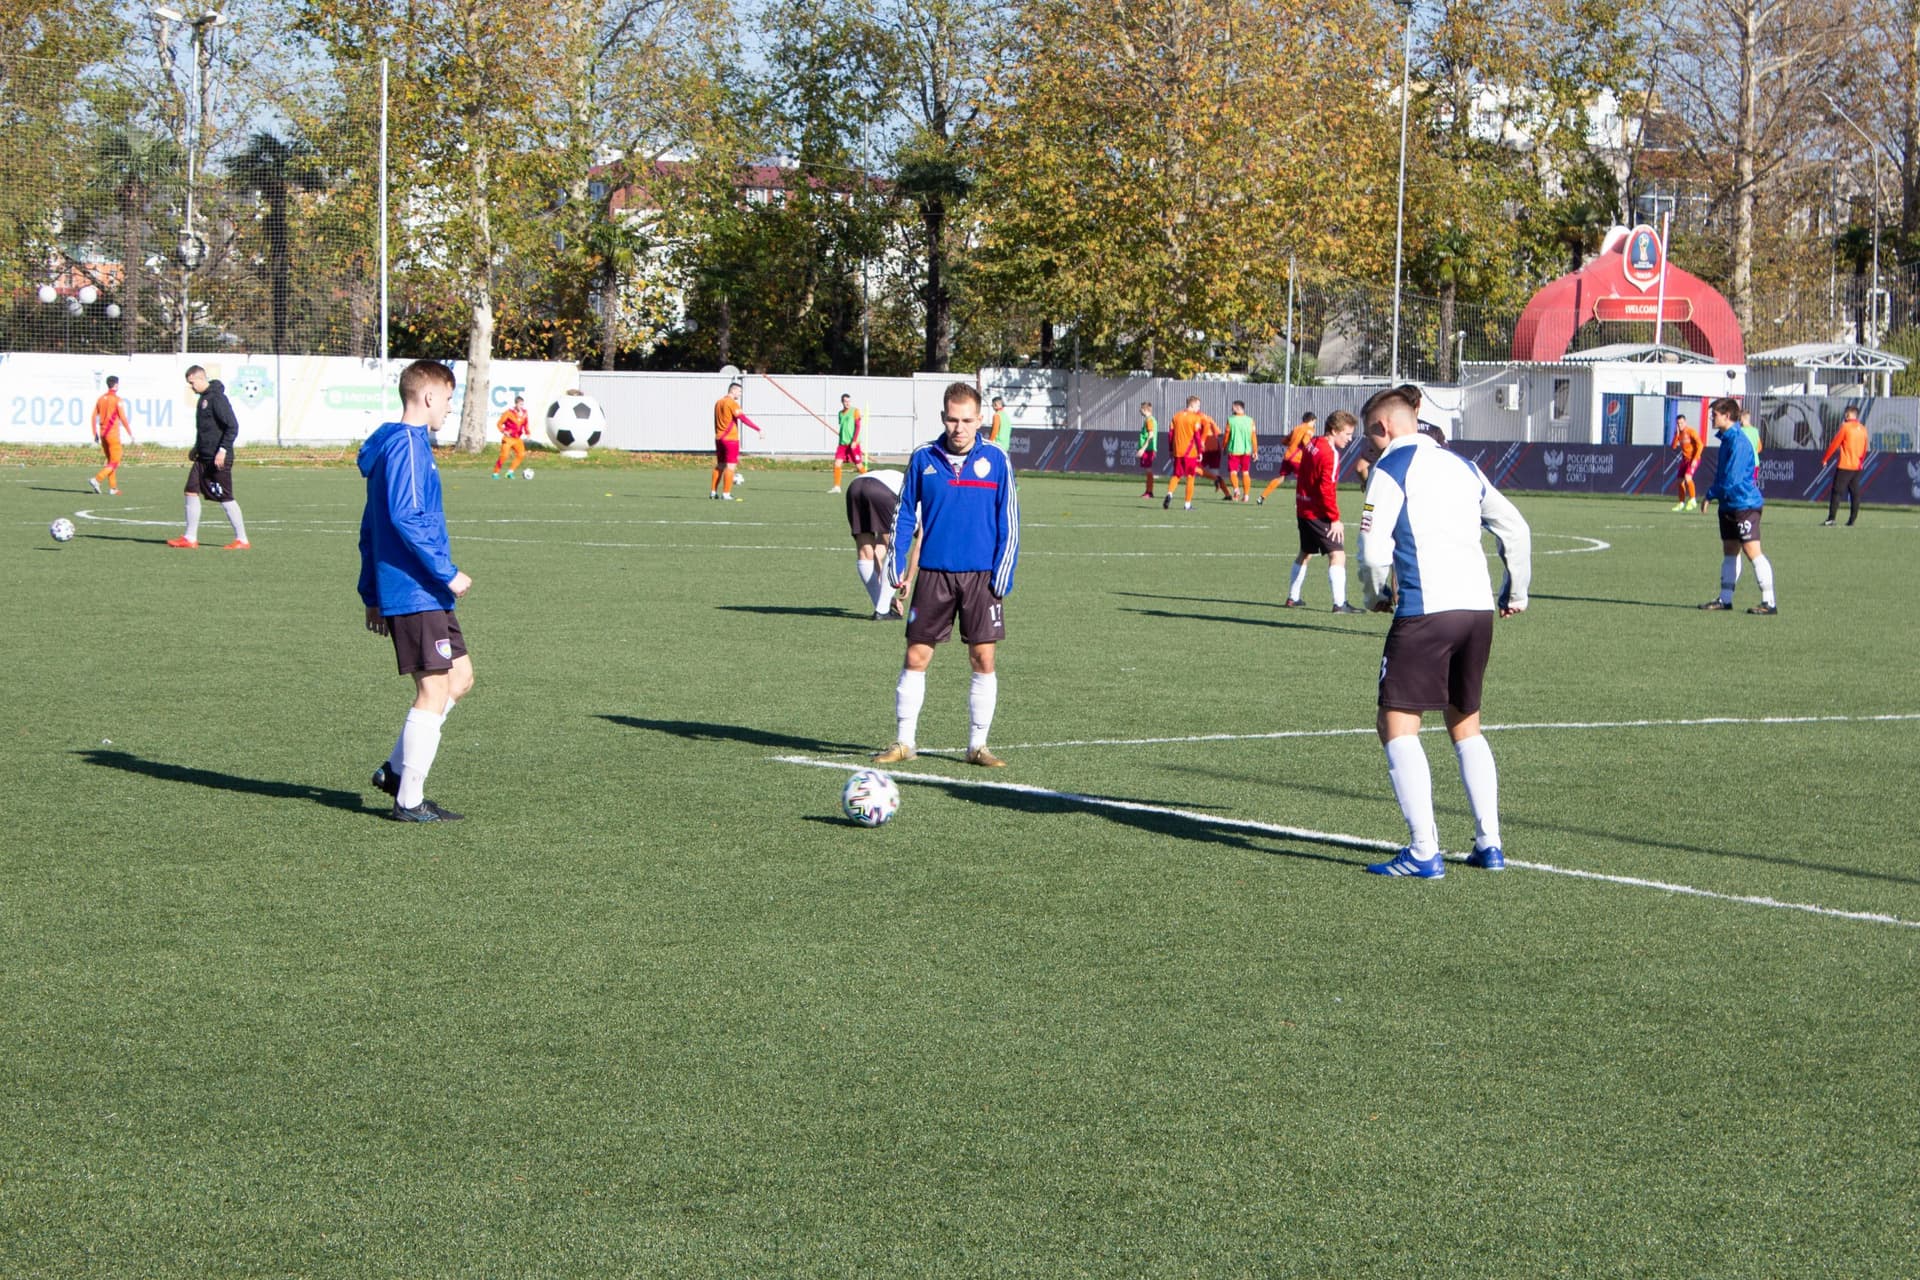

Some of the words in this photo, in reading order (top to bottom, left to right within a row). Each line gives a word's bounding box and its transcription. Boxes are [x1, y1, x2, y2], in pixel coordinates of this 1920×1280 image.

[1624, 304, 1657, 314] WELCOM
[11, 396, 83, 426] 2020
[1567, 454, 1614, 465] РОССИЙСКИЙ
[1567, 463, 1614, 474] ФУТБОЛЬНЫЙ
[1566, 472, 1586, 482] СОЮЗ
[1737, 519, 1751, 534] 29
